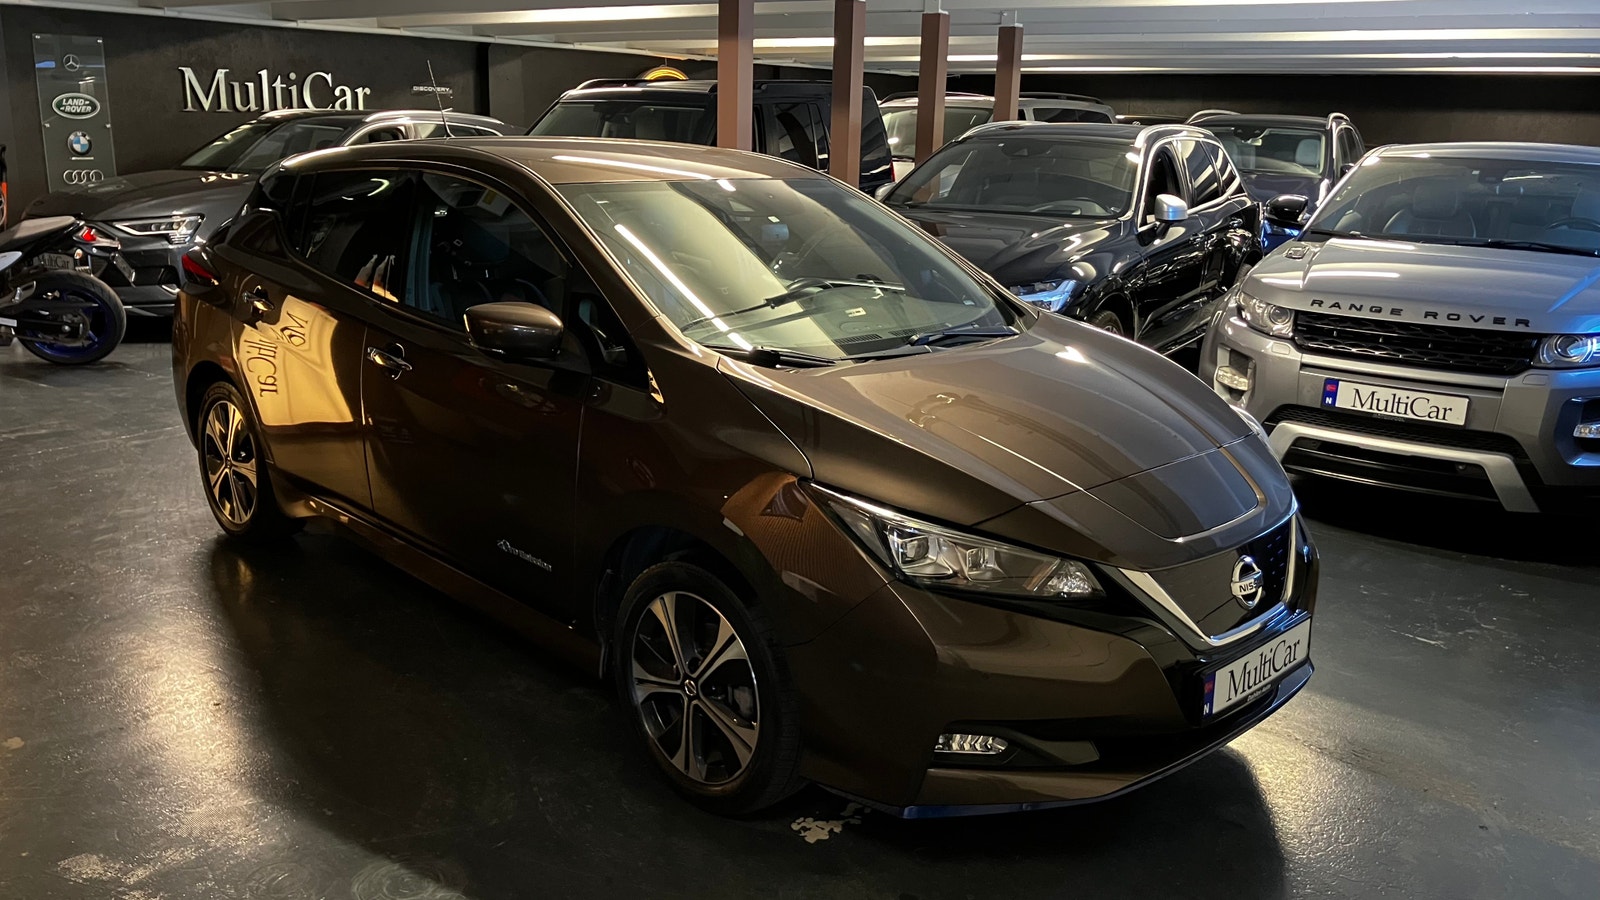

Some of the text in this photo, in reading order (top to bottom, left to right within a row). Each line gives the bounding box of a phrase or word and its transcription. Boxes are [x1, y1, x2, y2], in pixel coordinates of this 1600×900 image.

[178, 66, 371, 113] MultiCar
[62, 98, 85, 106] LAND
[64, 105, 92, 113] ROVER
[1310, 299, 1531, 327] RANGE ROVER
[1325, 396, 1332, 405] N
[1351, 387, 1453, 421] MultiCar
[1225, 639, 1300, 702] MultiCar
[1203, 702, 1210, 716] N
